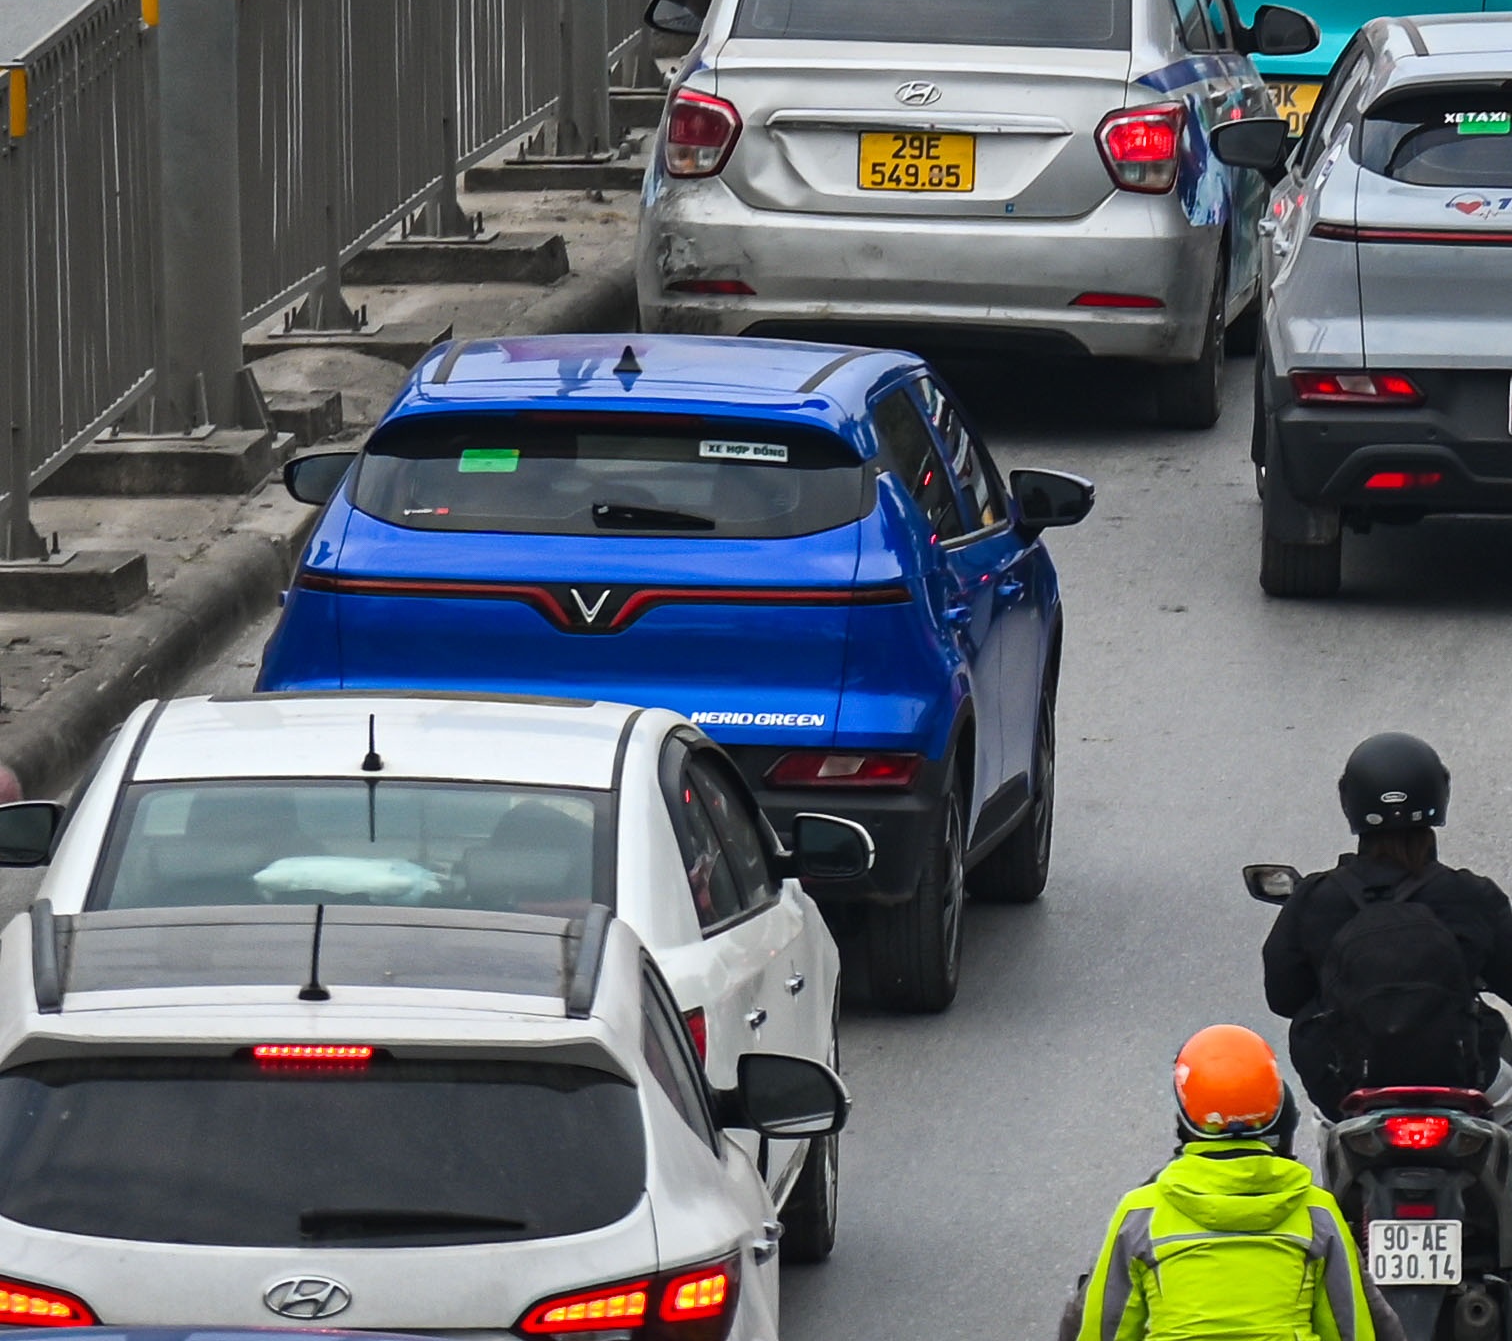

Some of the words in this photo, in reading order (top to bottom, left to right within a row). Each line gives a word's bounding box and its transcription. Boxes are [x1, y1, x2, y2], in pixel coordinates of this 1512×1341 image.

[891, 134, 942, 159] 29E
[869, 163, 961, 189] 549.85
[708, 444, 724, 453] XE
[726, 445, 749, 456] HỢP
[753, 443, 785, 458] ĐỒNG
[691, 711, 756, 725] HERIO
[756, 713, 825, 726] GREEN
[1383, 1225, 1448, 1251] 90-AE
[1375, 1253, 1456, 1280] 030.14
